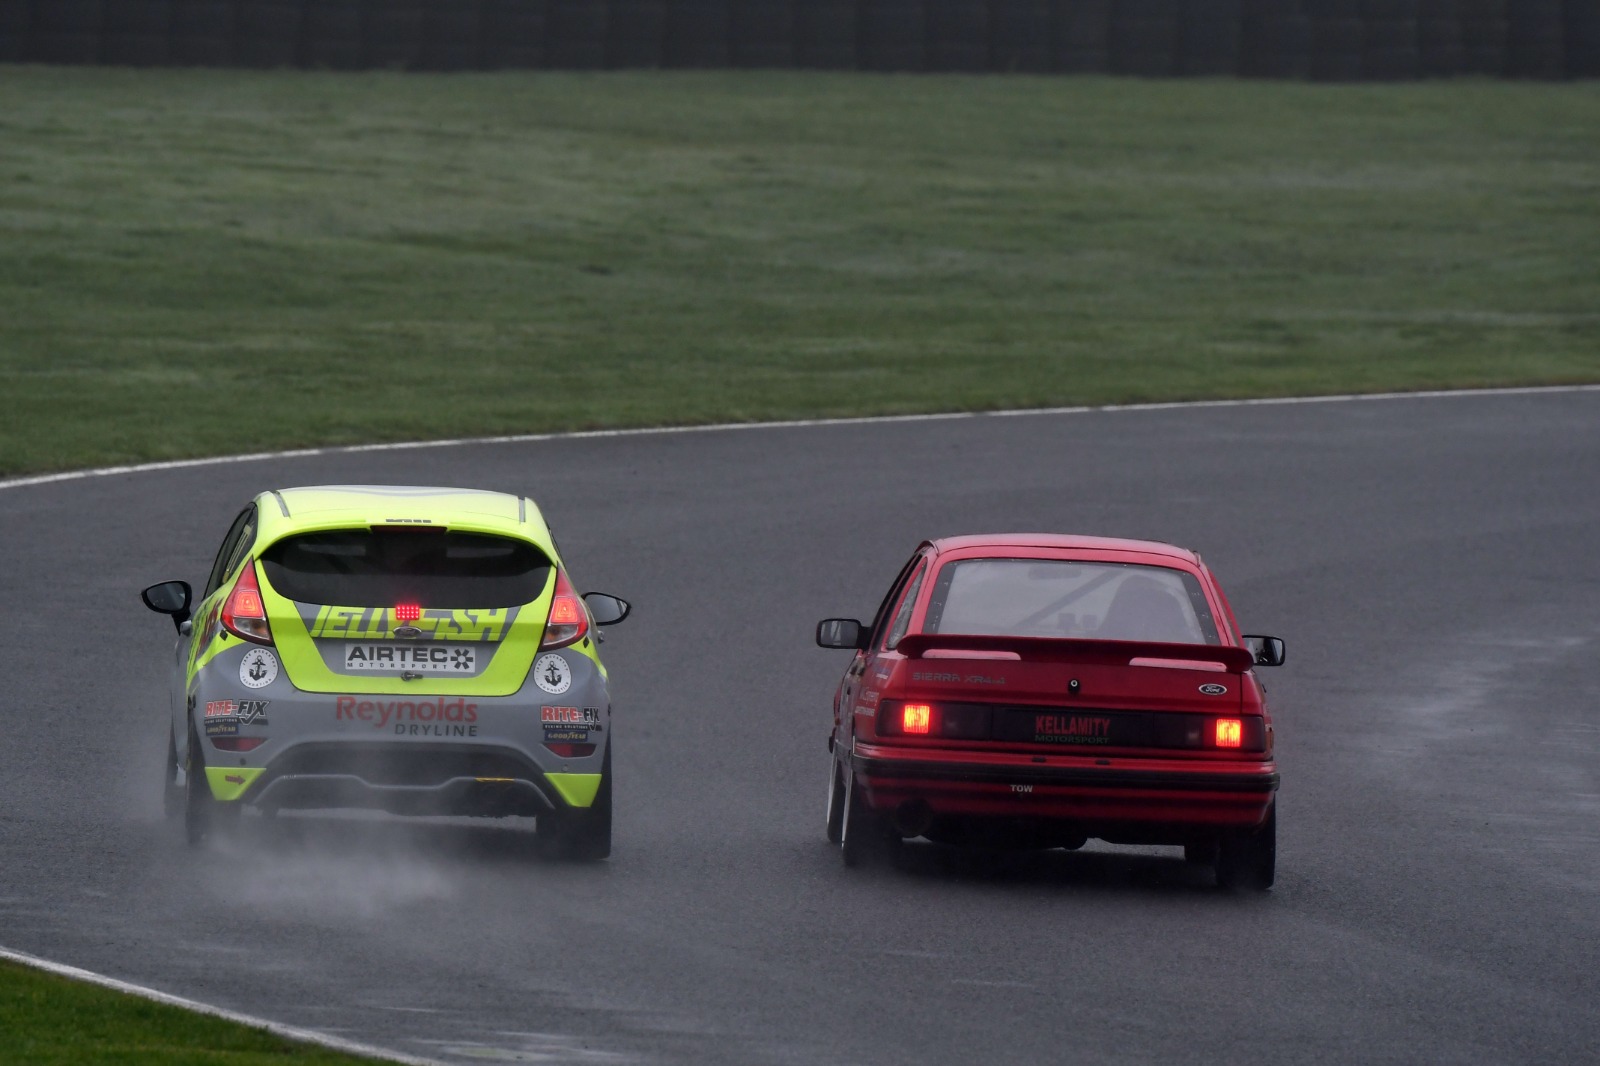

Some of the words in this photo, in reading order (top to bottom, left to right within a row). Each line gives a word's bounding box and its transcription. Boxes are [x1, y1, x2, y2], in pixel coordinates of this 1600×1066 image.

[347, 646, 448, 663] AIRTEC
[912, 672, 960, 682] SIERRA
[205, 700, 270, 723] RITE-FIX
[336, 695, 478, 729] Reynolds
[541, 706, 601, 729] RITE-FIX
[394, 723, 478, 737] DRYLINE
[1035, 715, 1111, 736] KELLAMITY
[1034, 734, 1110, 744] MOTORSPORT
[1010, 784, 1033, 793] TOW
